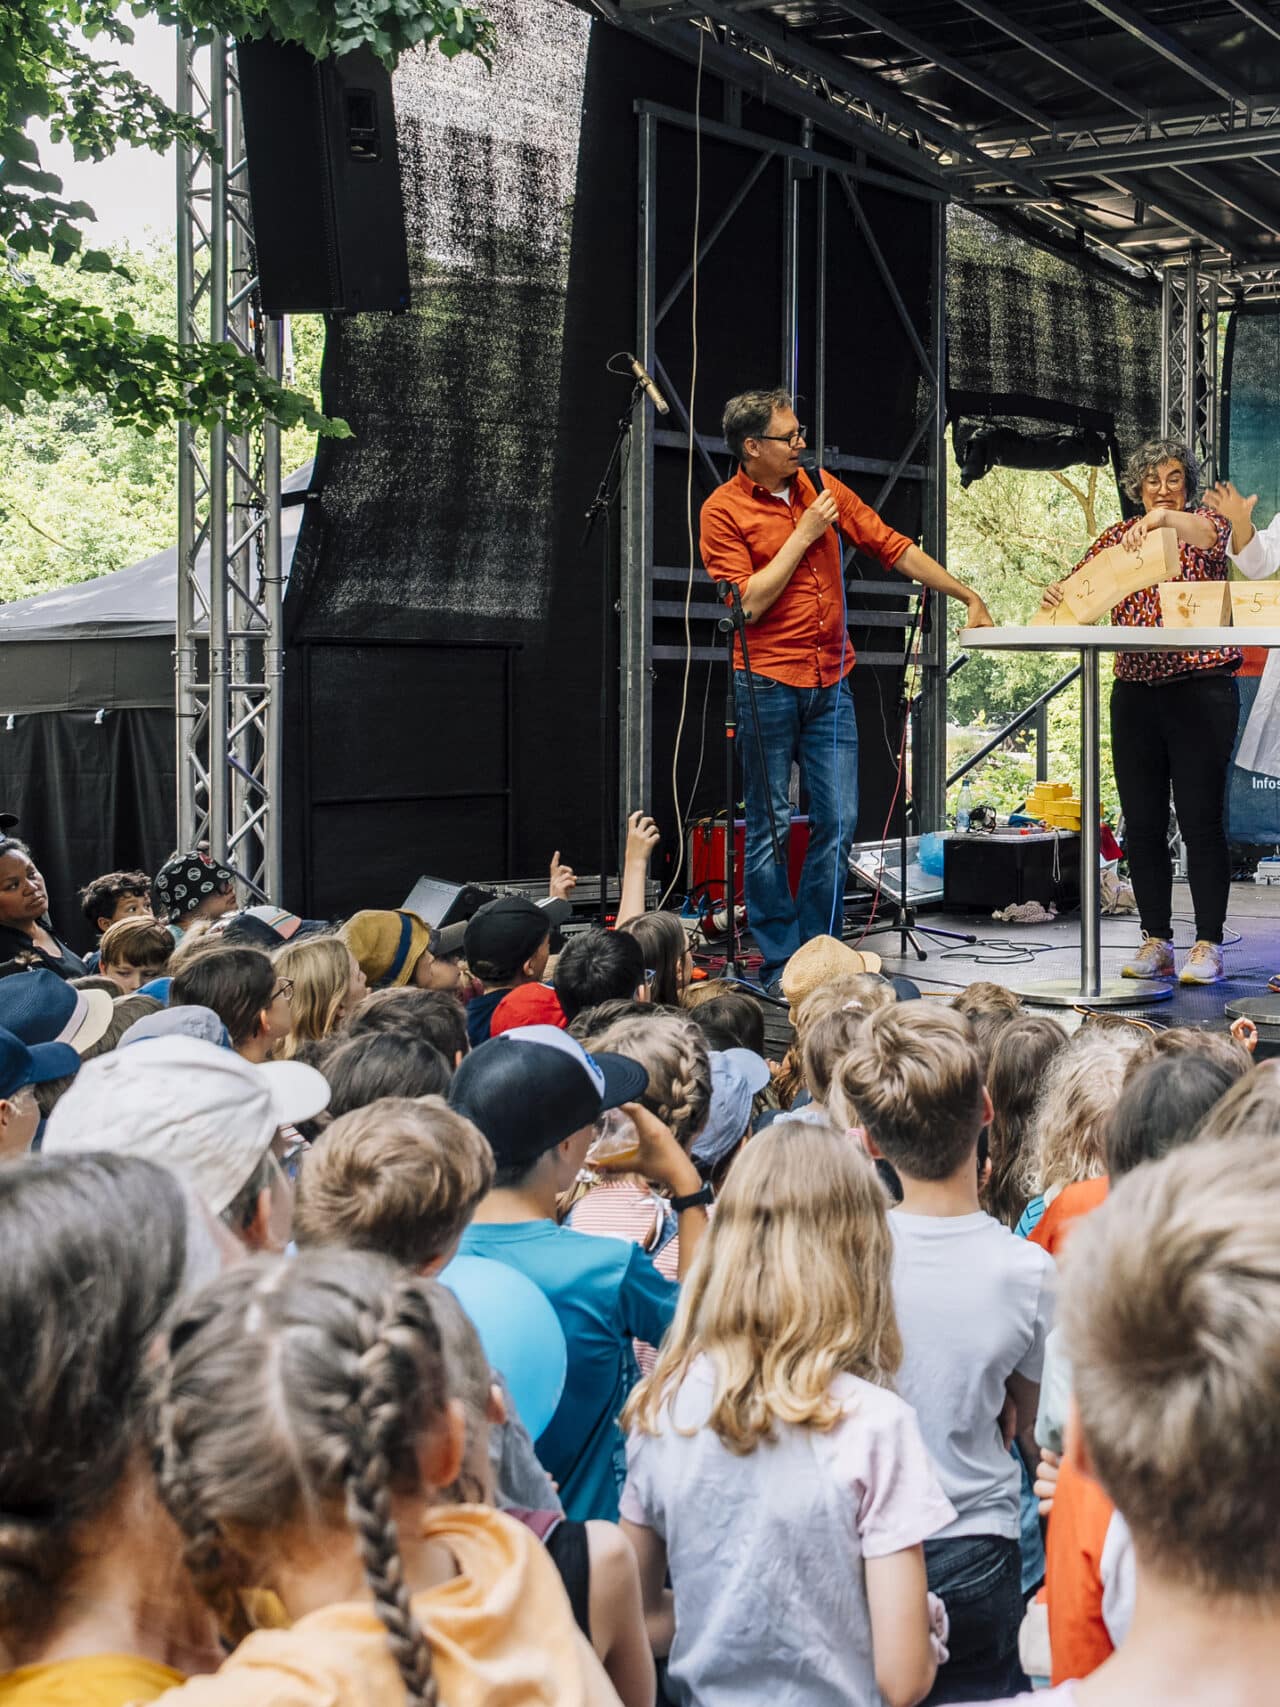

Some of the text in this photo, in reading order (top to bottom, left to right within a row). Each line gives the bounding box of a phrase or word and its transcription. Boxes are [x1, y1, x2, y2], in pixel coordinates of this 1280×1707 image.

[1134, 550, 1144, 570] 3
[1082, 579, 1095, 596] 2
[1186, 593, 1201, 614] 4
[1250, 593, 1263, 613] 5
